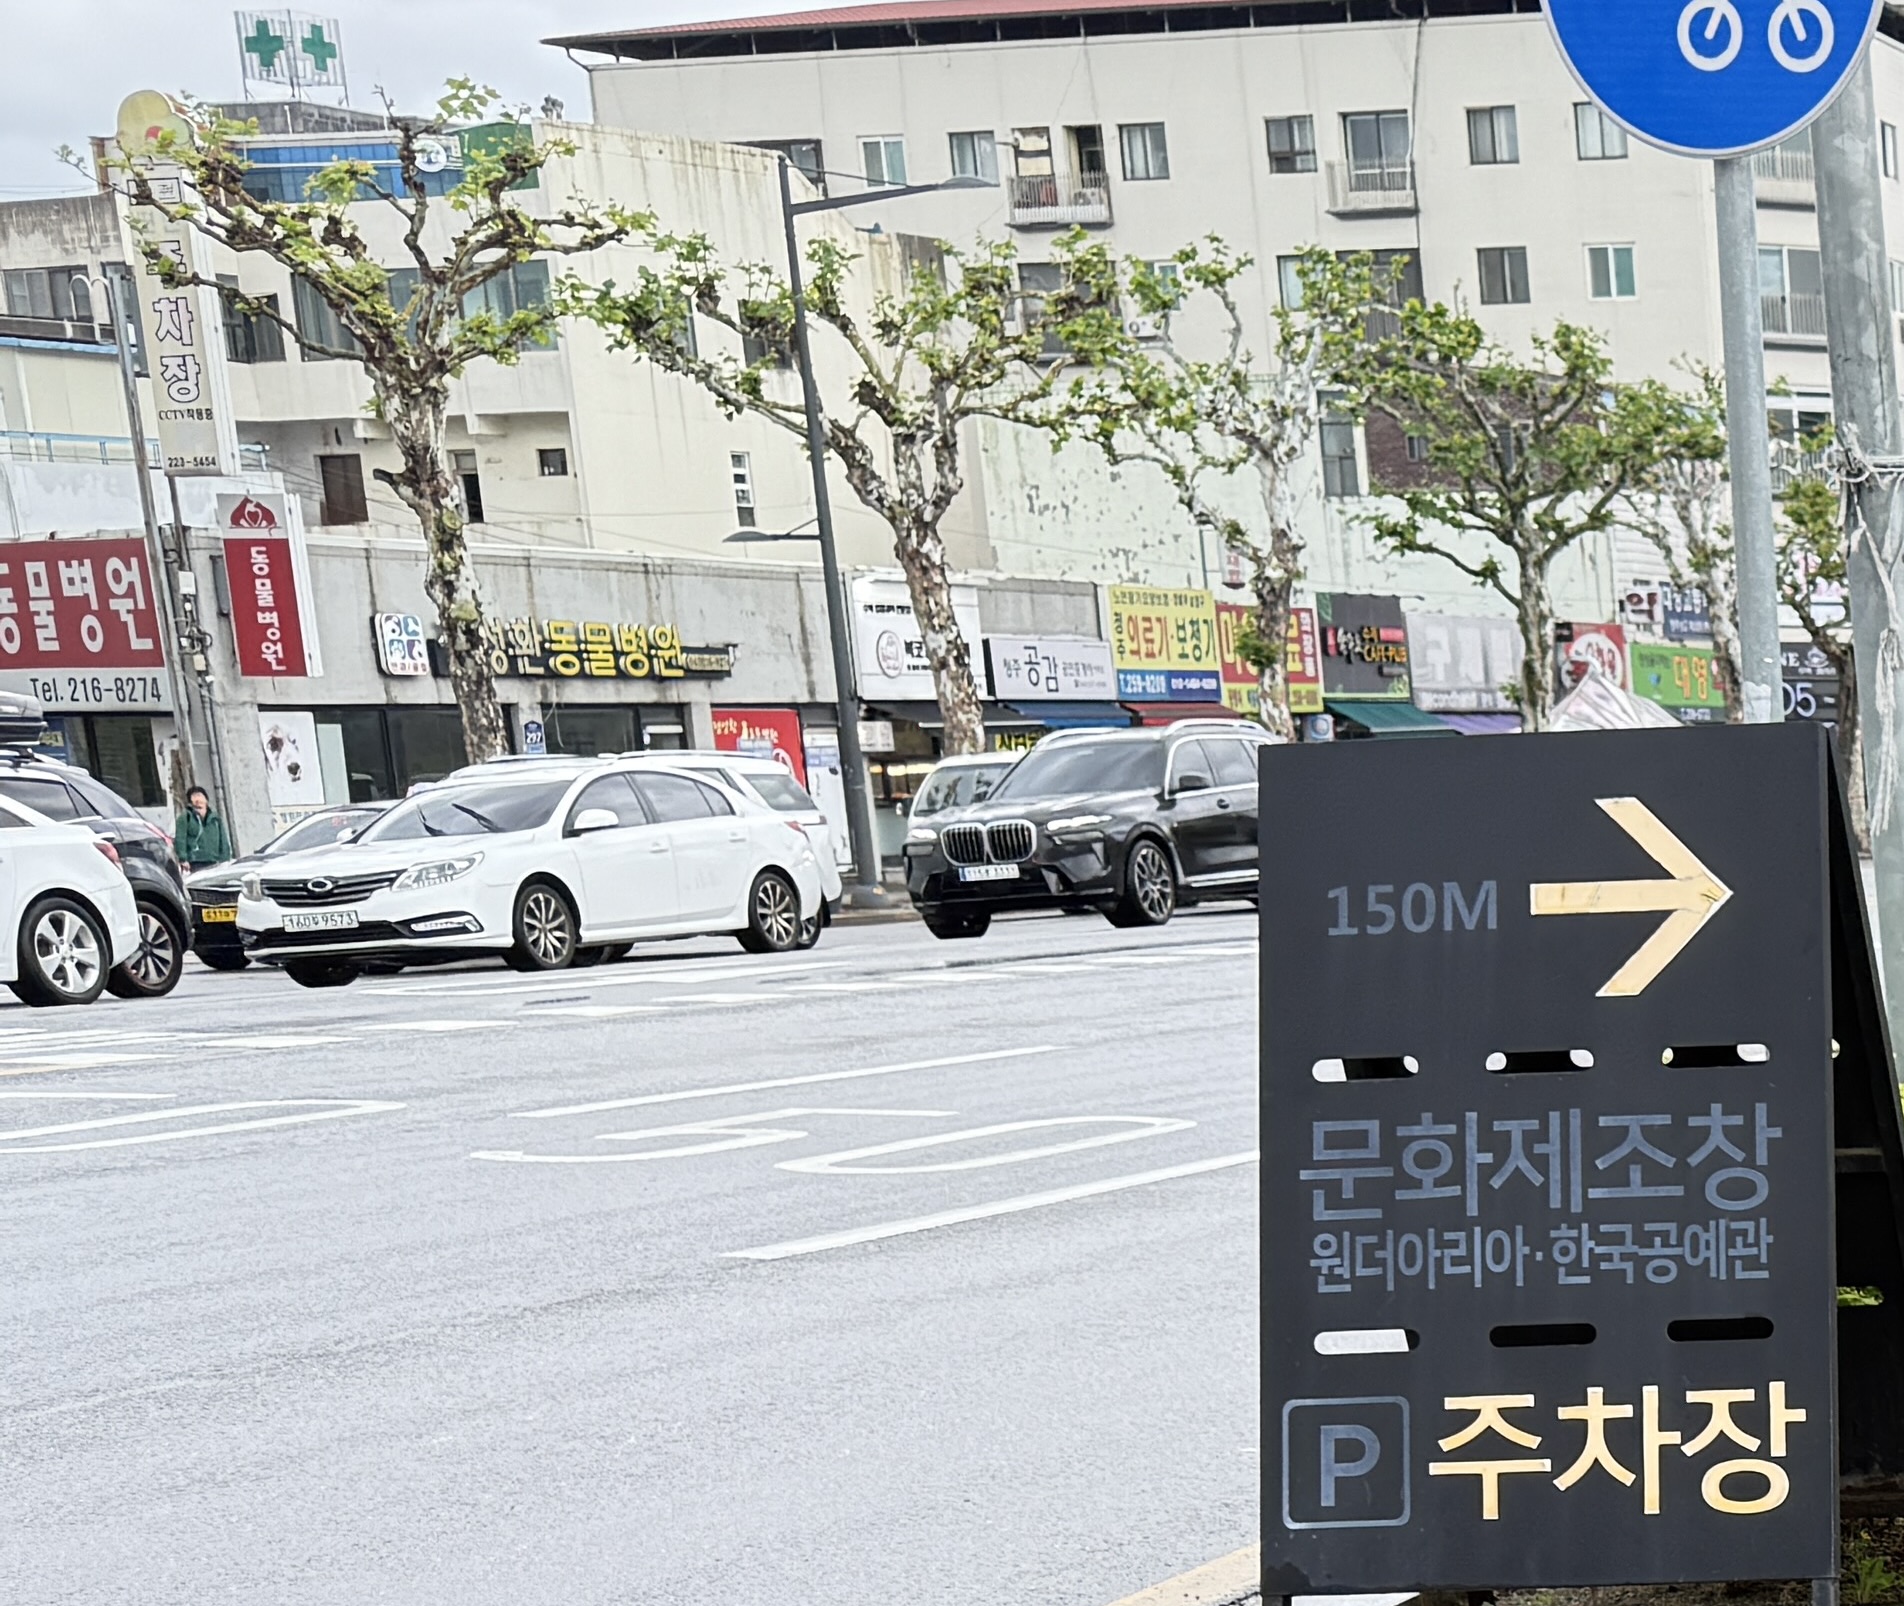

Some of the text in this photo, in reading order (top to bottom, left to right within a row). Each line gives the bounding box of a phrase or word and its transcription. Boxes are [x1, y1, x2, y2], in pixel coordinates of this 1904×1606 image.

[0, 557, 154, 655] 동물병원
[251, 546, 287, 671] 동물병원
[31, 677, 162, 703] Tel. 216-8274
[1023, 645, 1059, 693] 공감
[1327, 879, 1498, 937] 150M
[1299, 1102, 1782, 1221] 문화제조창
[1320, 1423, 1381, 1508] P
[1428, 1380, 1806, 1521] 주차장
